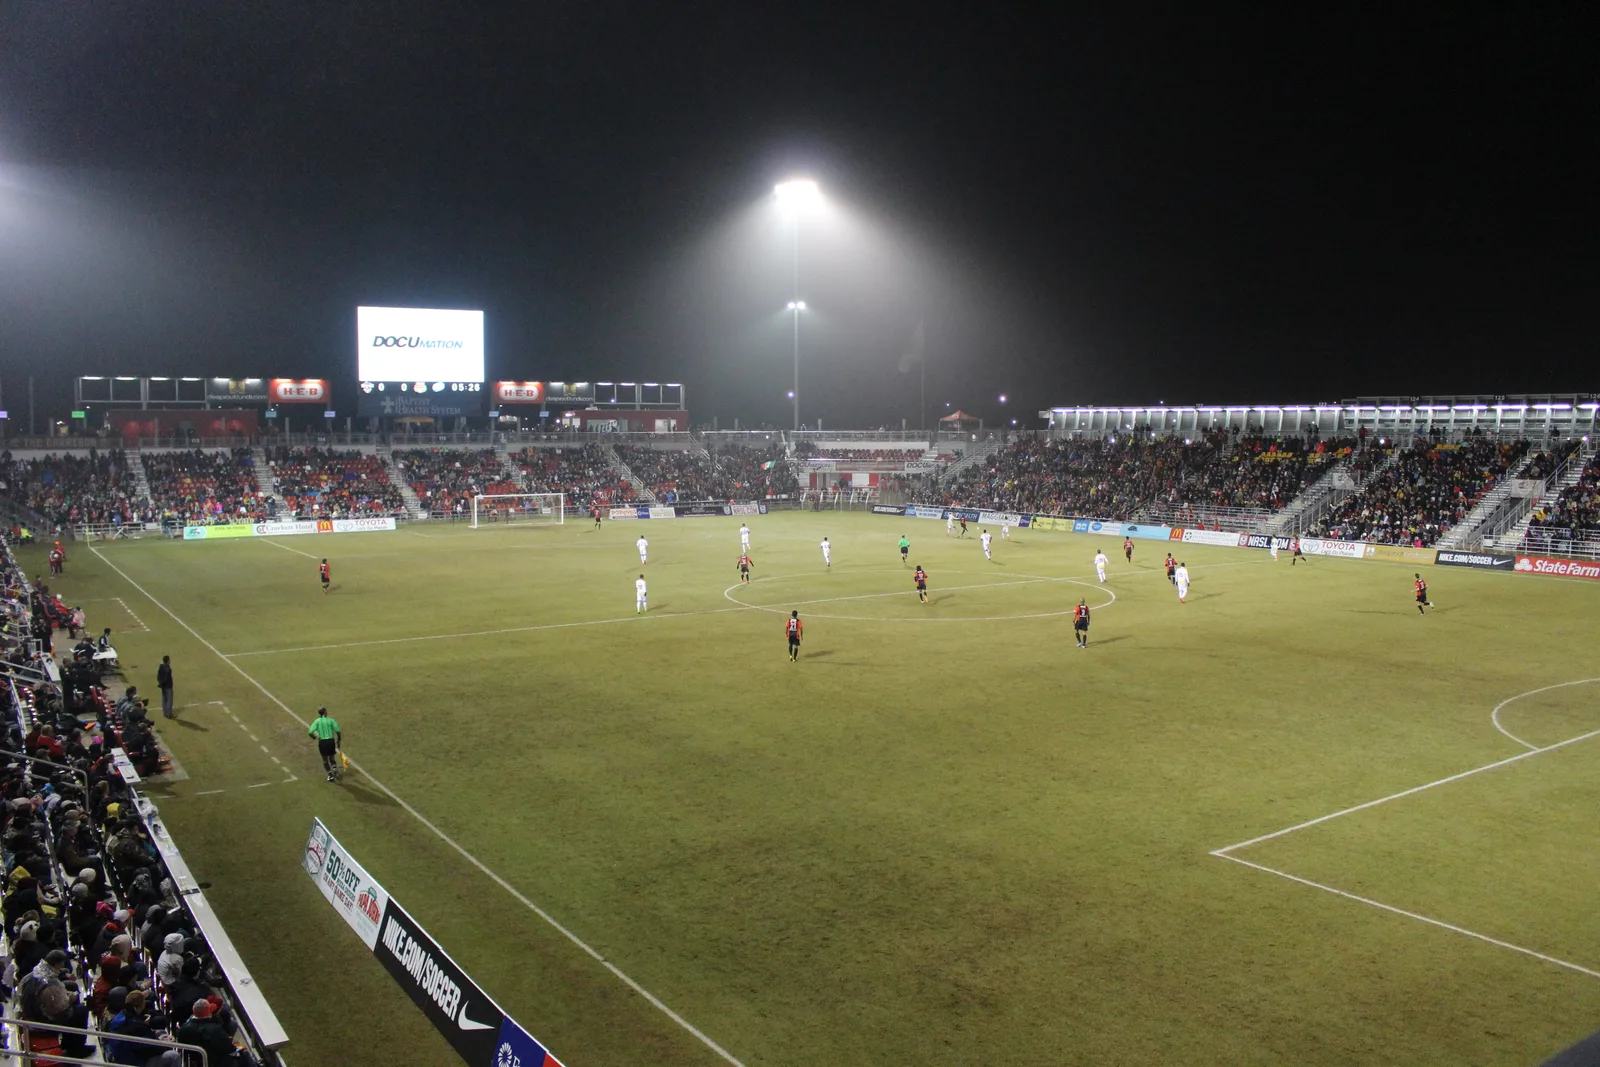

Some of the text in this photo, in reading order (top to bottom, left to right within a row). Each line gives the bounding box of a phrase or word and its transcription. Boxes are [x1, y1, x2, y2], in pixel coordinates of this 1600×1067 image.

[378, 382, 385, 391] 0
[401, 382, 408, 391] 0
[1247, 534, 1289, 550] NASL.OM
[1321, 541, 1356, 552] TOYOTA
[1438, 552, 1493, 566] NIKE.COM/SOCCER
[382, 915, 461, 1022] NIKE.COM/SOCCER
